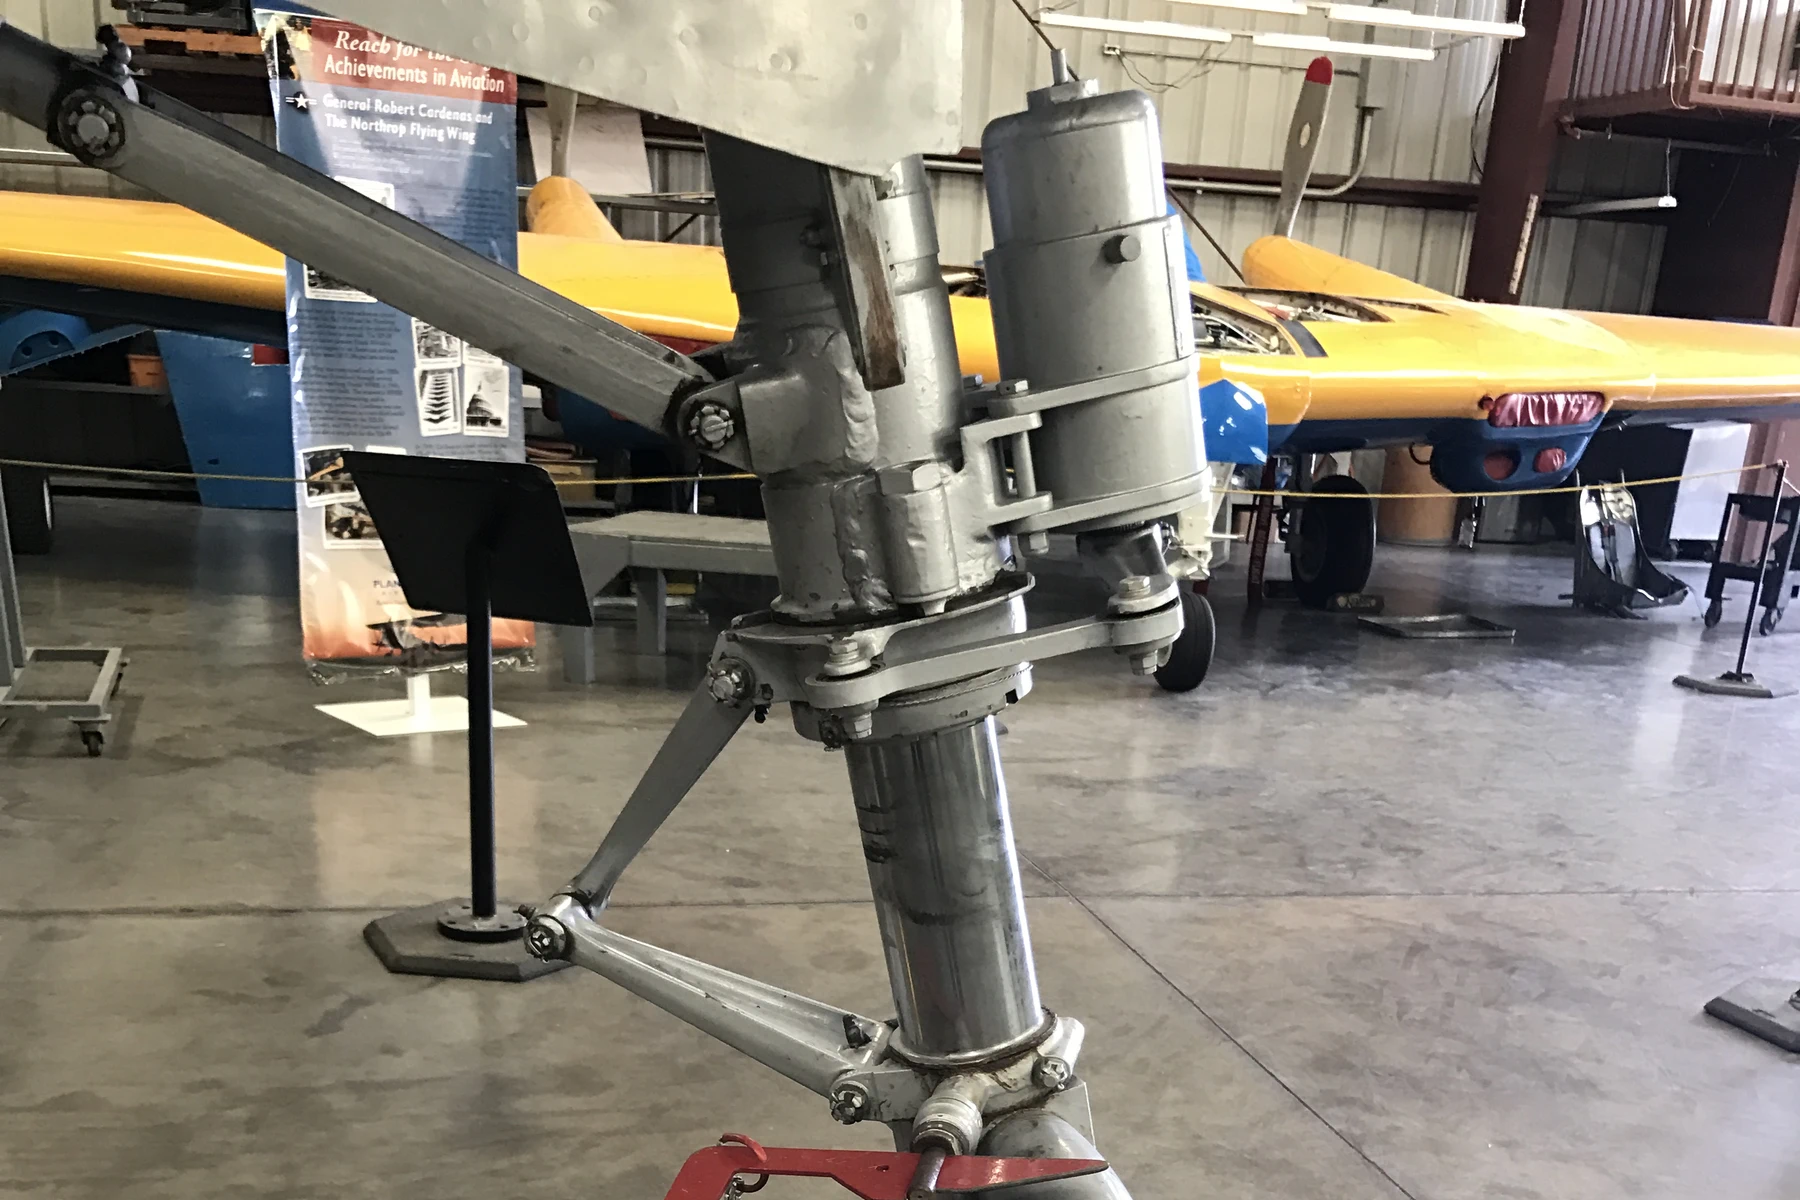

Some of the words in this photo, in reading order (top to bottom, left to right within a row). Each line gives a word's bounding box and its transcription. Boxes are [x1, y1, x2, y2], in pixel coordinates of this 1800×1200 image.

[334, 30, 391, 54] Reach
[393, 41, 423, 61] for
[324, 54, 427, 84] Achievements
[433, 67, 446, 86] in
[450, 68, 504, 93] Aviation
[323, 93, 371, 111] General
[374, 98, 415, 116] Robert
[418, 103, 472, 122] Cardenas
[475, 111, 493, 124] and
[324, 112, 348, 128] The
[351, 116, 406, 138] Northrop
[410, 122, 444, 142] Flying
[446, 126, 476, 145] Wing
